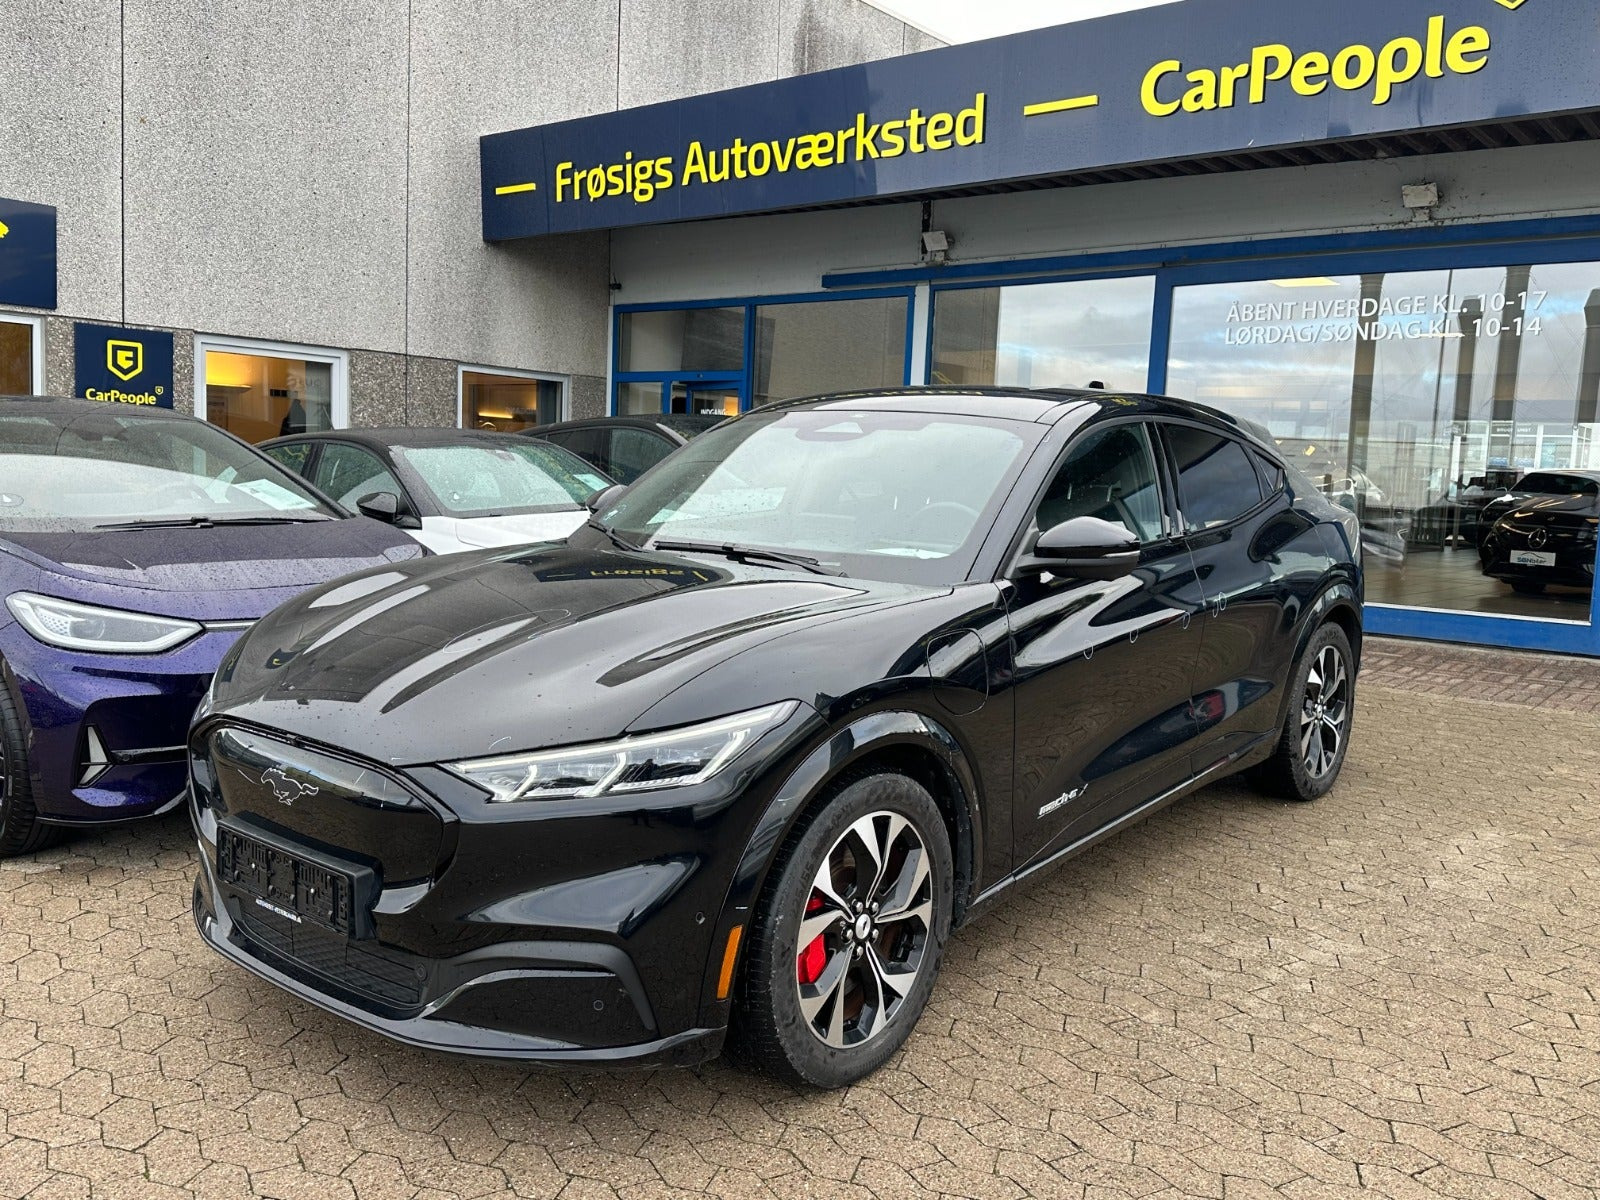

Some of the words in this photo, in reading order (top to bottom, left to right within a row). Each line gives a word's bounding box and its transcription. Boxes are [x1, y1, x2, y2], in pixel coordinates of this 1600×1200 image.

[1140, 15, 1491, 117] CarPeople
[556, 152, 674, 202] Frøsigs
[682, 93, 986, 186] Autoværksted
[1226, 300, 1298, 322] ÅBENT
[1302, 295, 1426, 320] HVERDAGE
[1433, 293, 1468, 314] KL.
[1477, 291, 1548, 312] 10-17
[1225, 321, 1422, 345] LØRDAG/SØNDAG
[1473, 317, 1542, 337] 10-14
[85, 387, 157, 406] CarPeople
